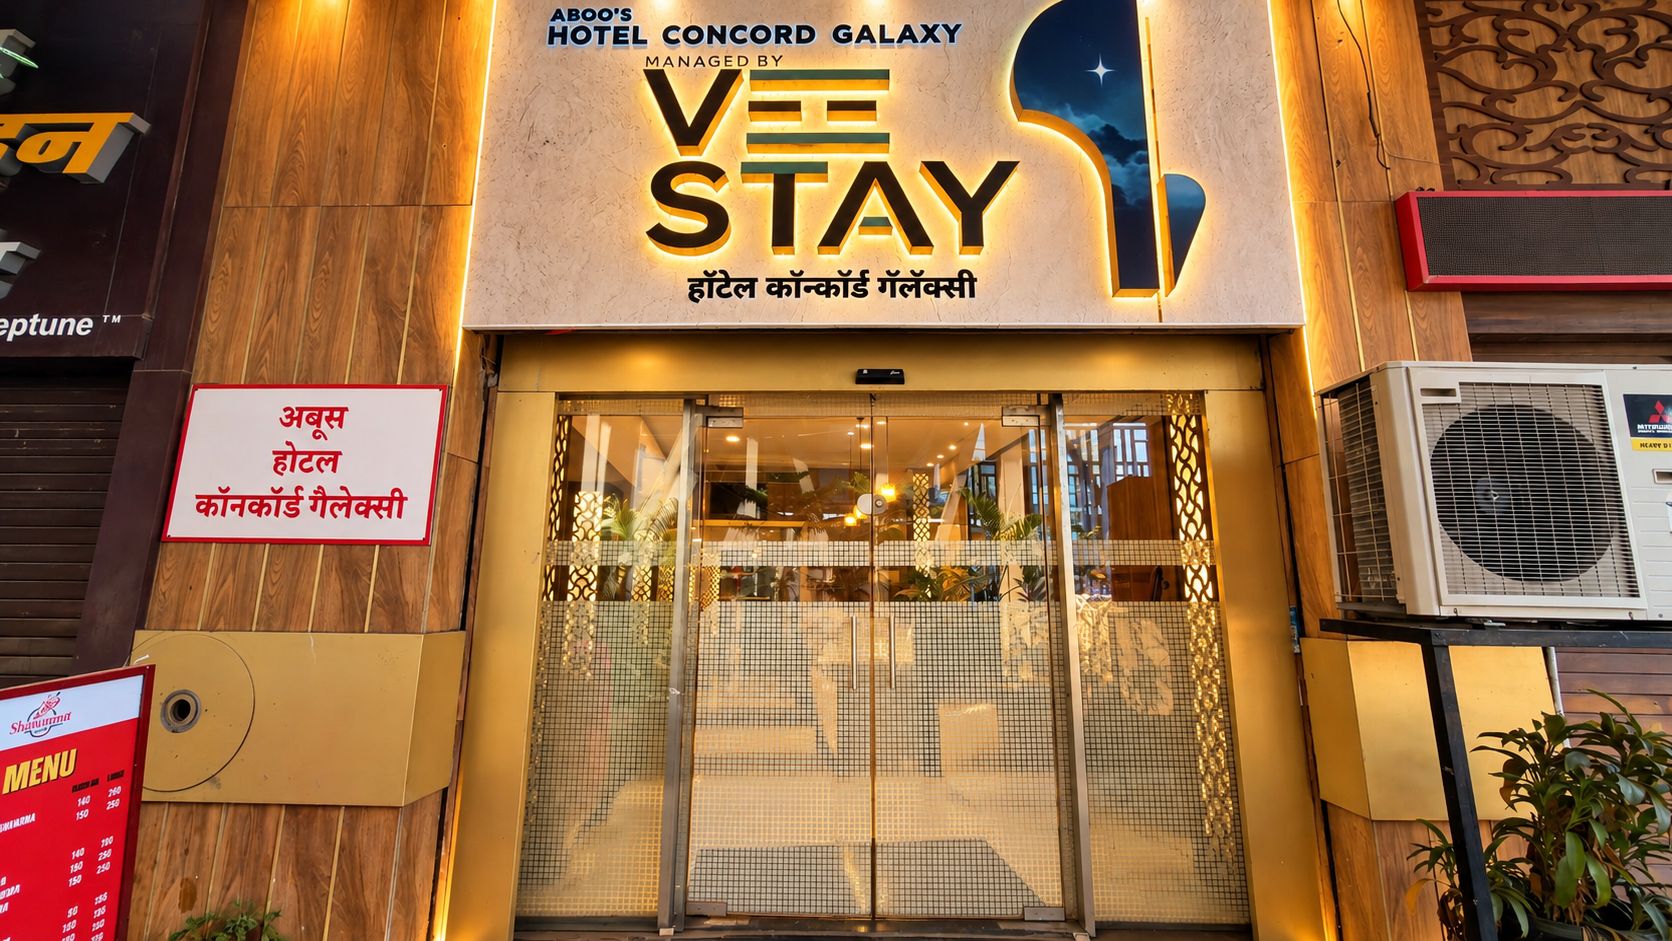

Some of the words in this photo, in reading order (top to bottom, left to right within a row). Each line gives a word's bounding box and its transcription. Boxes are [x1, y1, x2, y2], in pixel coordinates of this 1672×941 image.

[550, 7, 633, 23] ABOO'S
[547, 25, 649, 46] HOTEL
[662, 24, 816, 46] CONCORD
[832, 23, 963, 45] GALAXY
[645, 55, 749, 68] MANAGED
[757, 55, 783, 68] BY
[645, 160, 1020, 256] STAY
[687, 269, 758, 303] हॉटेल
[766, 269, 870, 299] कॉन्कॉर्ड
[877, 268, 978, 299] गॅलॅक्सी
[279, 406, 349, 441] अबूस
[271, 440, 343, 477] होटल
[194, 486, 304, 519] कॉनकॉर्ड
[309, 486, 408, 520] गैलेक्सी
[2, 748, 78, 795] MENU
